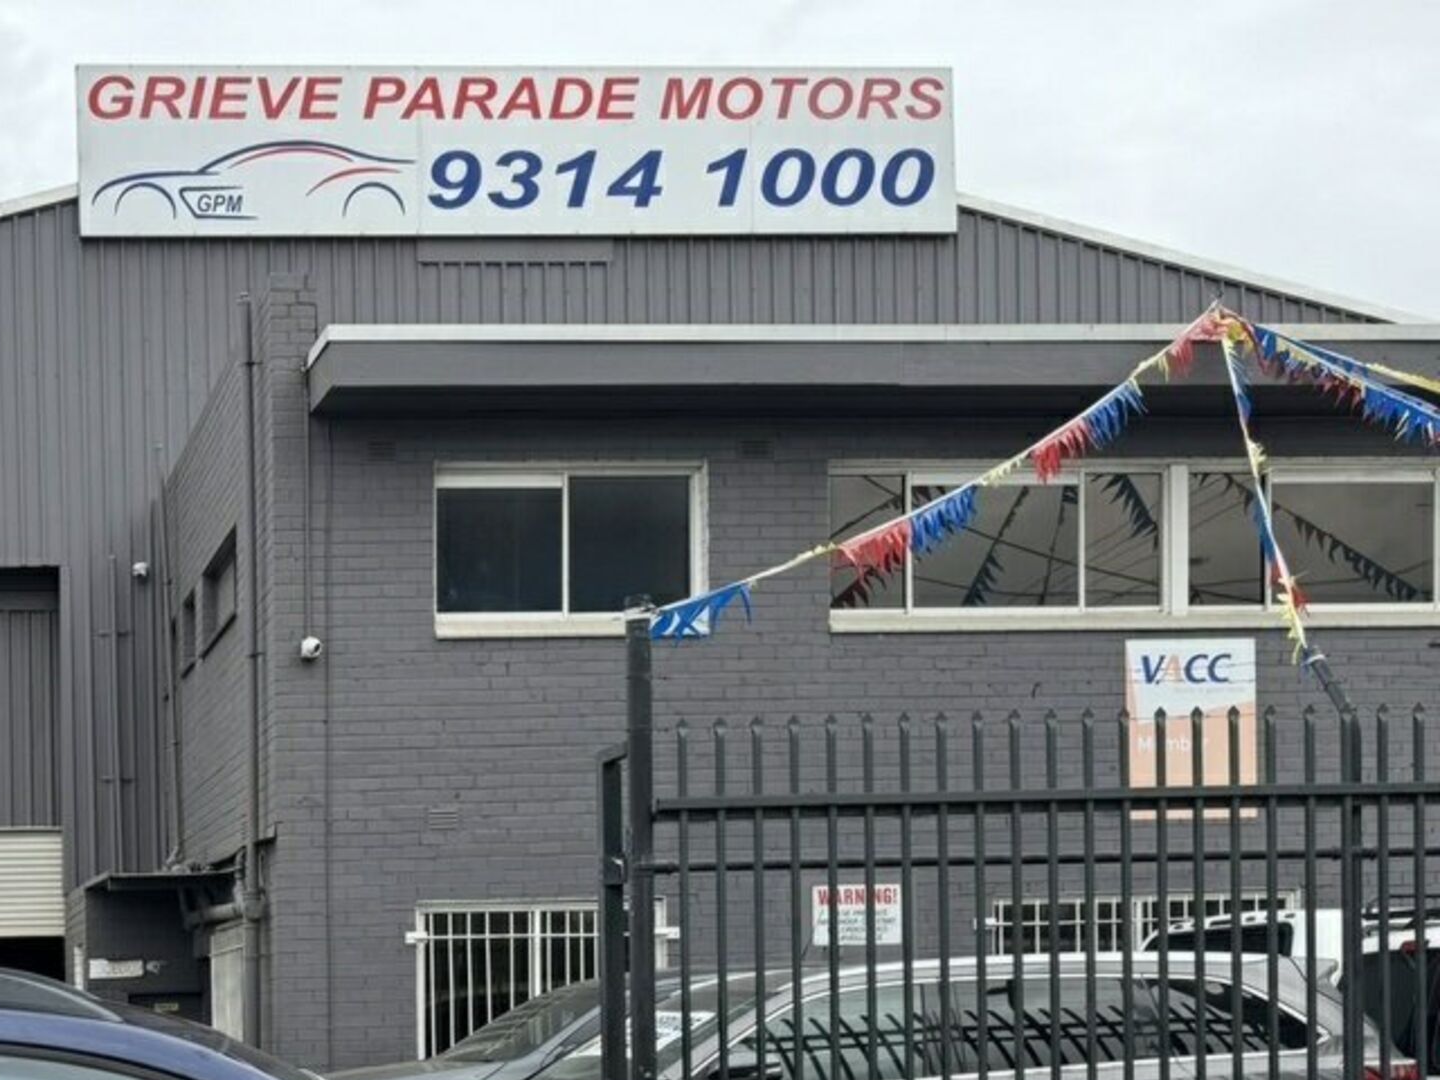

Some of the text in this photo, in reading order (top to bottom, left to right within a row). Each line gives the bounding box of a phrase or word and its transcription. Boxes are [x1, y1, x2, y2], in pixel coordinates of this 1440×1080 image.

[87, 75, 945, 121] GRIEVE PARADE MOTORS
[427, 148, 936, 210] 9314 1000
[196, 193, 244, 213] GPM
[1141, 653, 1233, 685] VACC
